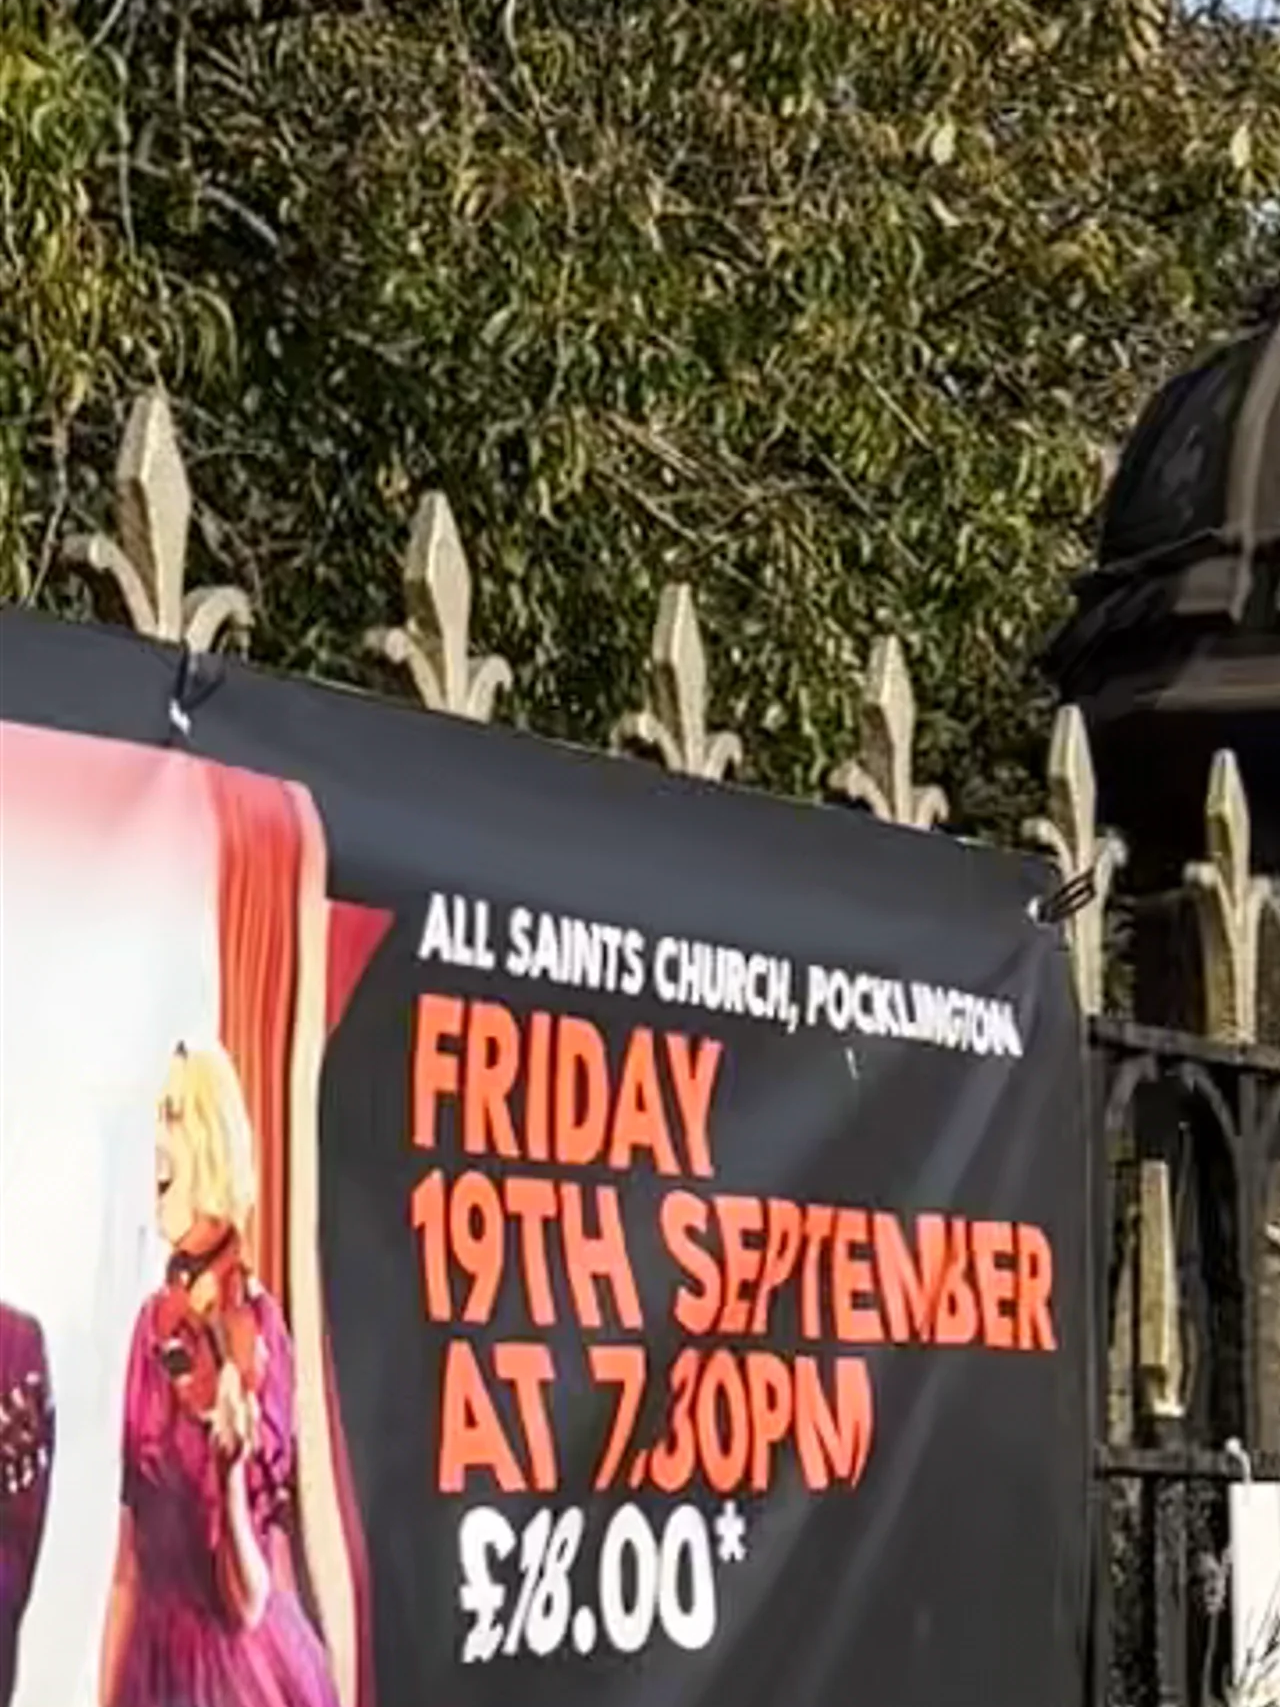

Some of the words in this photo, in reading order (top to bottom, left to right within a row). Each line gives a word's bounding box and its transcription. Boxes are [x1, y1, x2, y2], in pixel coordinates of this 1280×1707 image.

[419, 892, 496, 970] ALL
[506, 906, 646, 996] SAINTS
[654, 936, 798, 1033] CHURCH,
[806, 964, 1022, 1057] POCKLINGTON
[411, 993, 724, 1180] FRIDAY
[411, 1169, 644, 1330] 19TH
[659, 1190, 1057, 1351] SEPTEMBER
[438, 1339, 558, 1493] AT
[588, 1343, 874, 1493] 7.30PM
